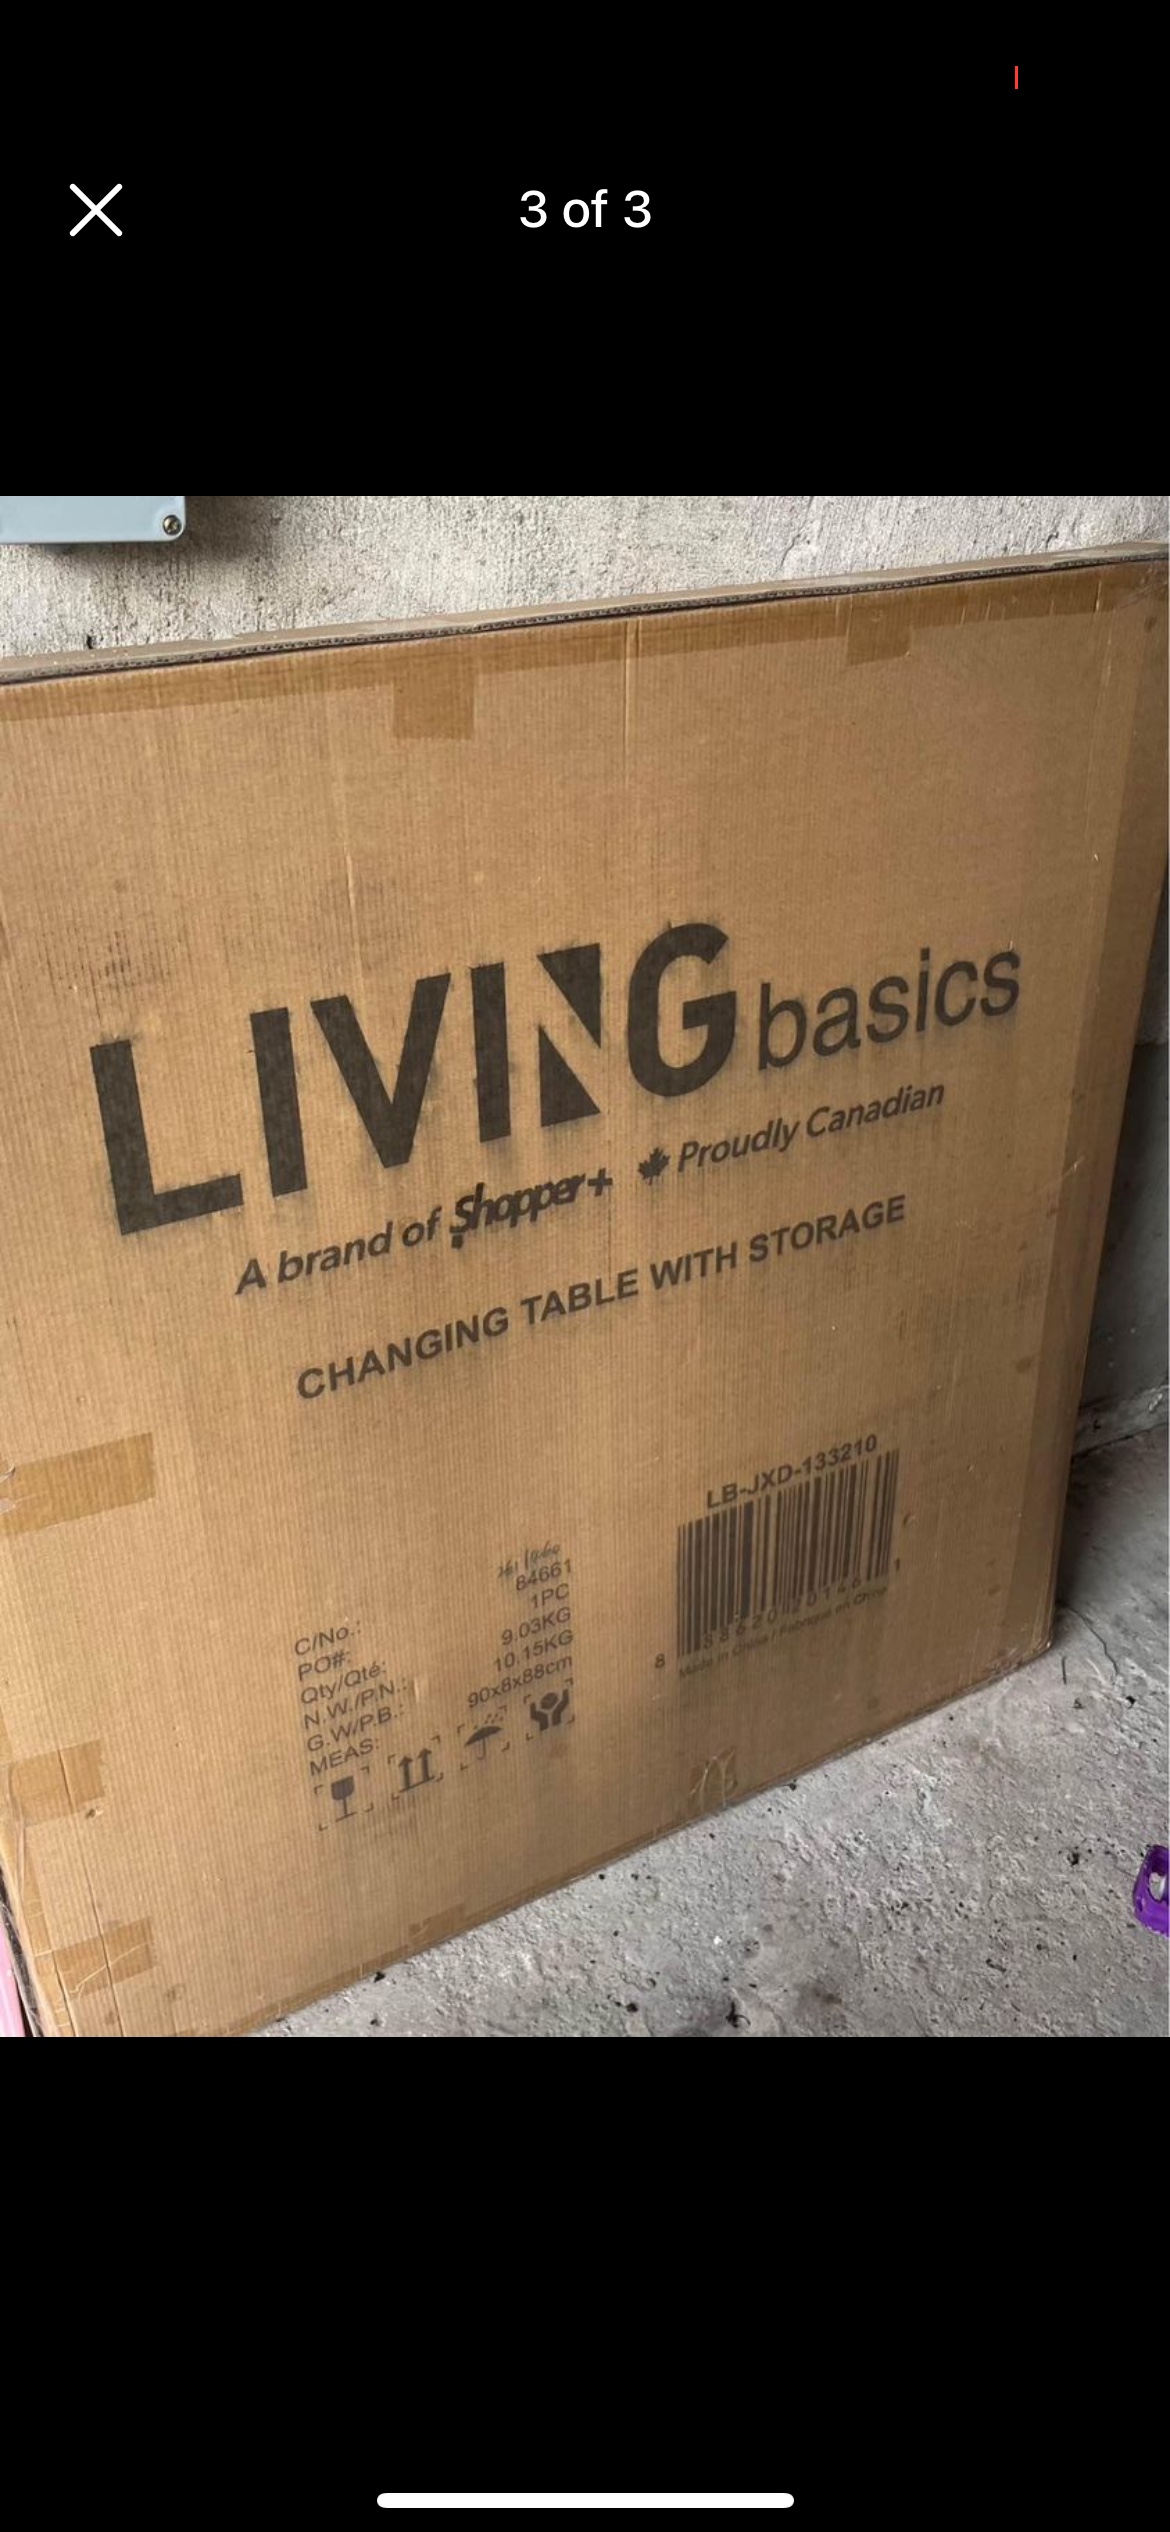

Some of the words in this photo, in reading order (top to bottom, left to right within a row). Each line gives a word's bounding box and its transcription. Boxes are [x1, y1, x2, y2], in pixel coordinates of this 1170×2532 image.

[89, 922, 738, 1236] LIVING
[756, 947, 1022, 1073] basics
[235, 1258, 266, 1295] A
[277, 1221, 394, 1284] brand
[401, 1205, 444, 1249] of
[677, 1116, 800, 1173] Proudly
[805, 1083, 946, 1138] Canadian
[296, 1305, 511, 1400] CHANGING
[520, 1268, 639, 1326] TABLE
[649, 1241, 738, 1292] WITH
[748, 1194, 907, 1264] STORAGE
[706, 1433, 878, 1509] LB-JXD-133210
[294, 1620, 361, 1656] C/No.:
[298, 1650, 351, 1681] PO#:
[514, 1558, 573, 1592] 84661
[299, 1661, 387, 1706] Qty/Qté:
[531, 1583, 570, 1610] 1PC
[493, 1628, 574, 1672] 10.15KG
[500, 1606, 572, 1646] 9.03KG
[654, 1652, 666, 1669] 8
[309, 1737, 380, 1776] MEAS:
[467, 1655, 573, 1708] 90x8x88cm
